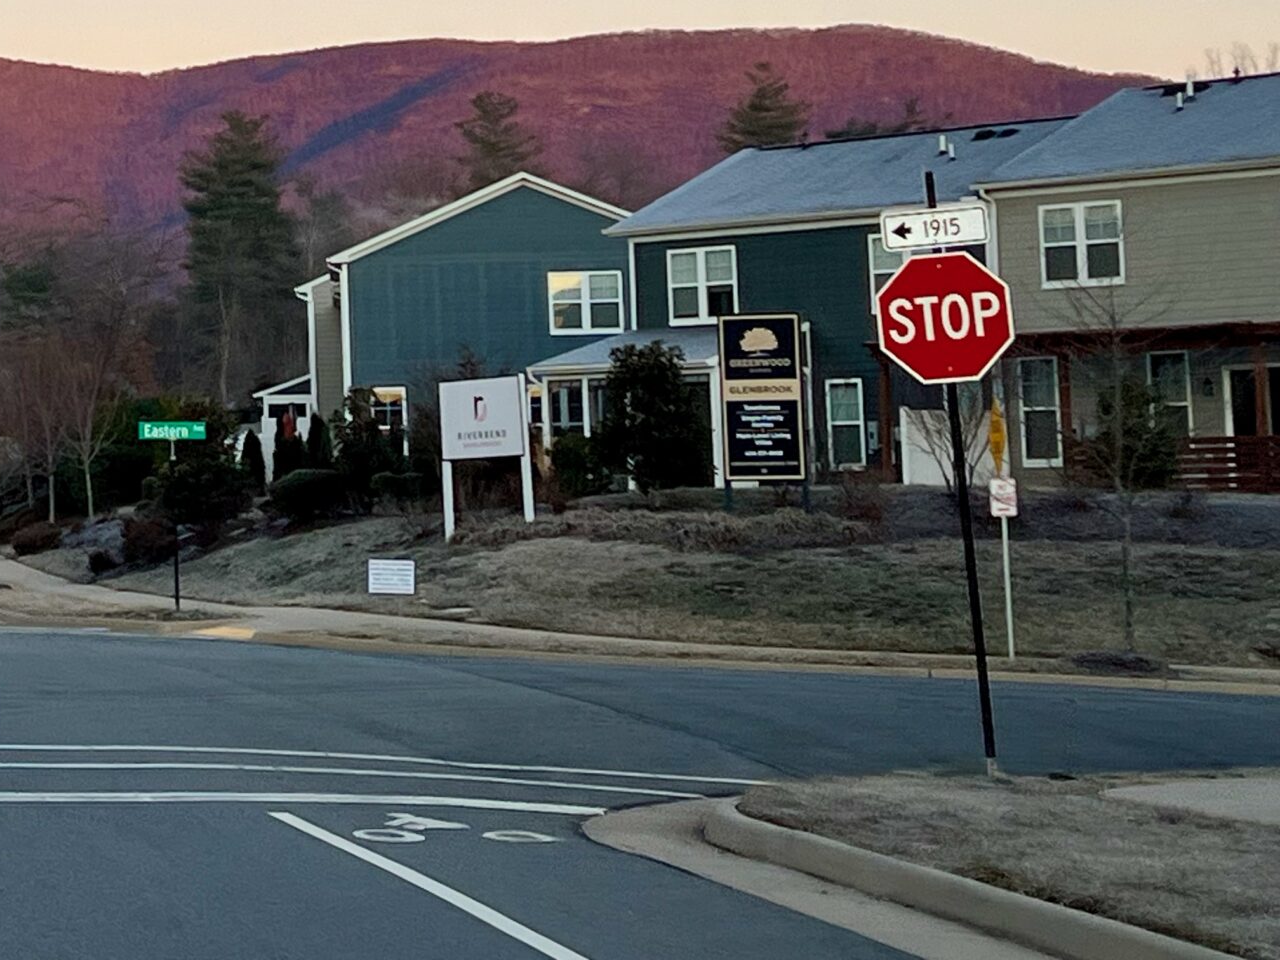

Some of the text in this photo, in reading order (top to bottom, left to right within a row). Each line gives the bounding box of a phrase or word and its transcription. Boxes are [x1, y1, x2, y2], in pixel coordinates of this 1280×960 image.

[923, 218, 961, 238] 1915
[888, 291, 1001, 345] STOP
[729, 385, 793, 395] GLENBROOK
[144, 424, 189, 438] Eastern
[457, 429, 507, 440] RIVERBEND
